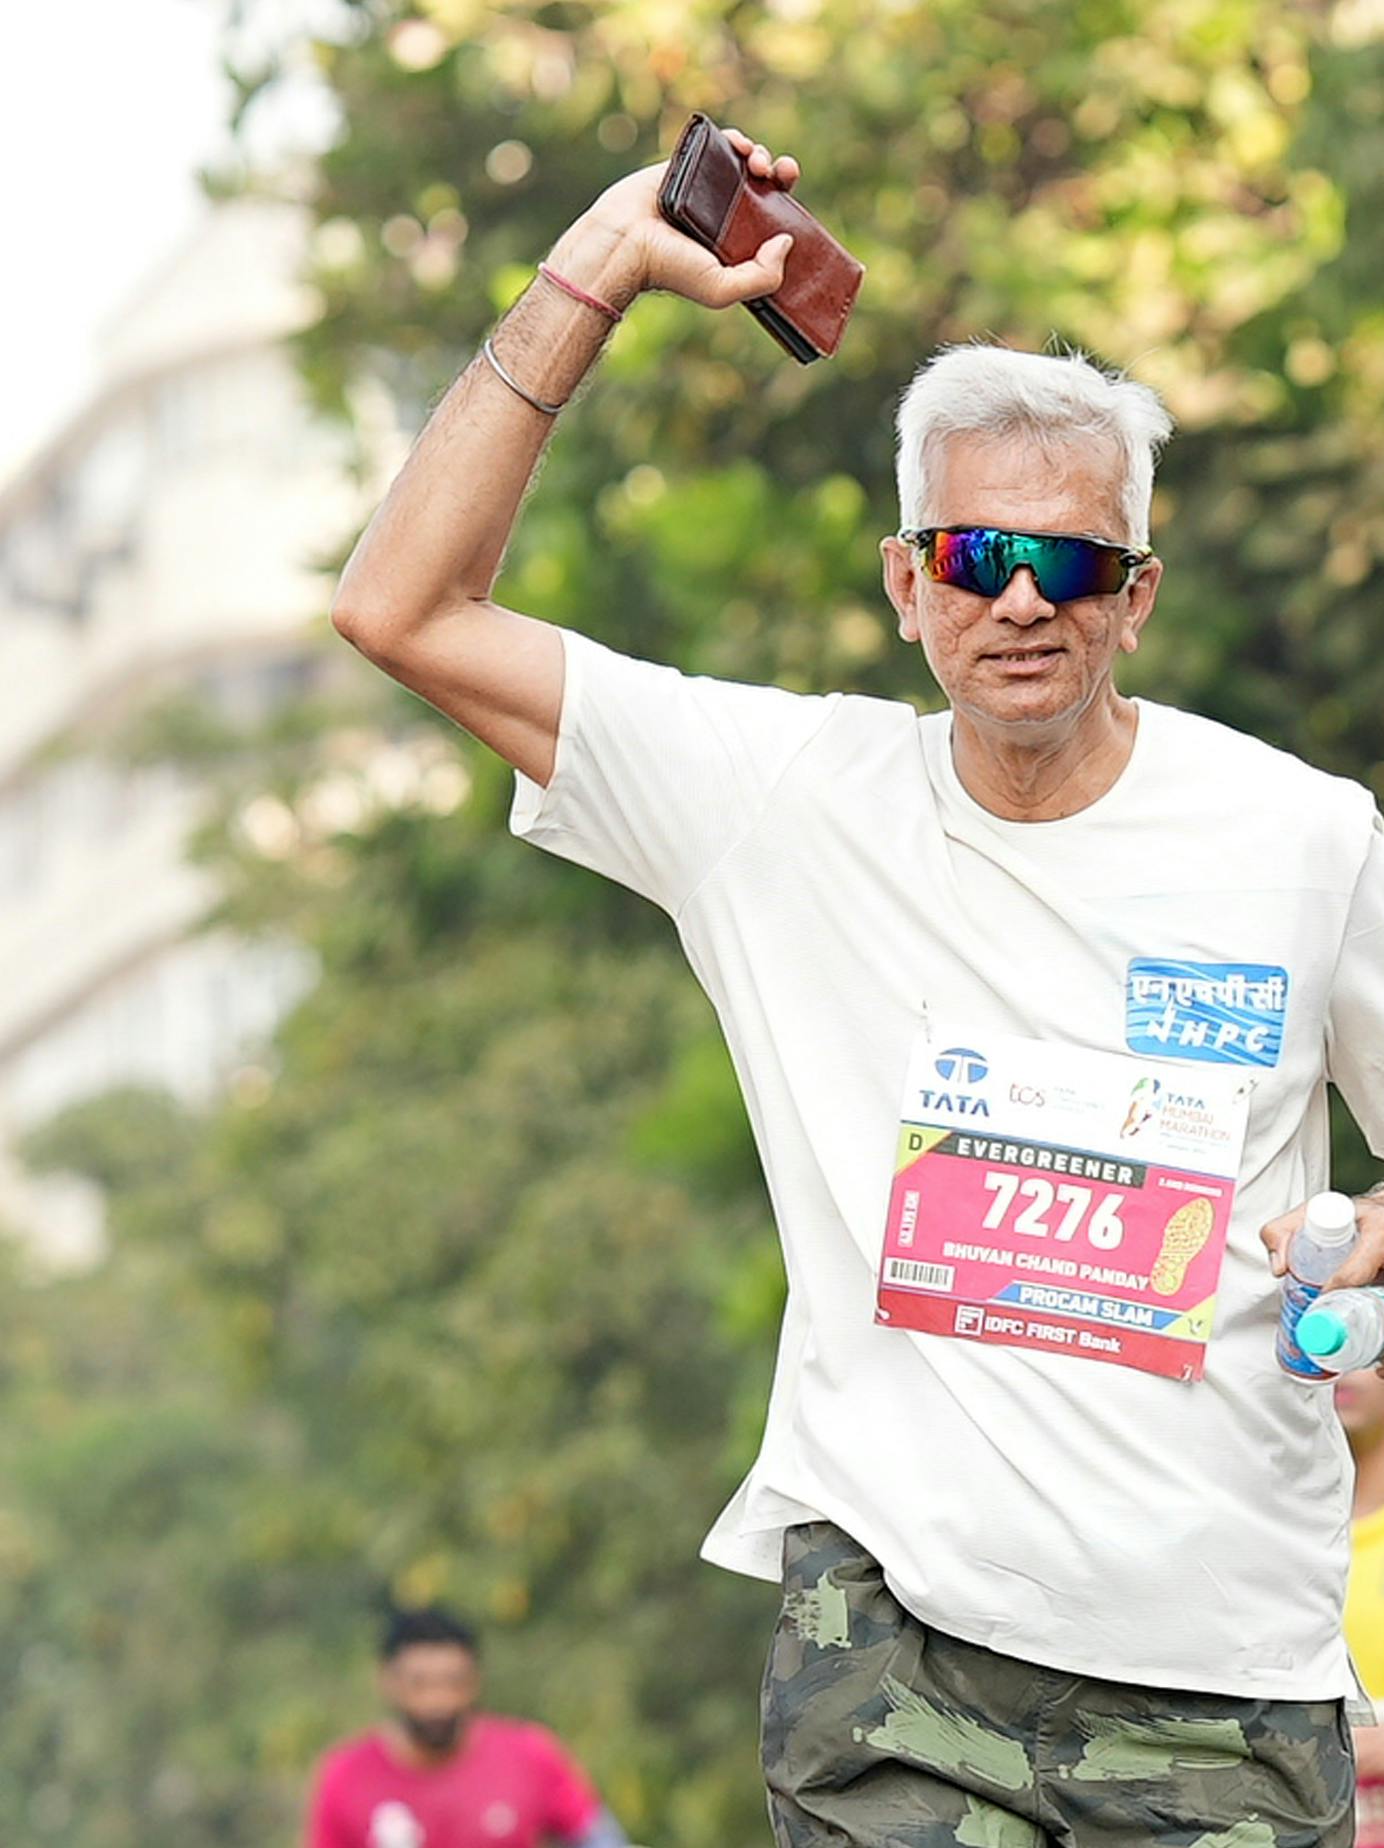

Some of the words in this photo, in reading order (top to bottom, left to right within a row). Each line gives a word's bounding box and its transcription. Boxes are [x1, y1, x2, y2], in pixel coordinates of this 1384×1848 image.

[1146, 1005, 1268, 1052] NHPC
[919, 1089, 990, 1117] TATA
[1167, 1092, 1206, 1109] TATA
[909, 1133, 923, 1151] D
[1159, 1119, 1231, 1141] MARATHON
[957, 1138, 1133, 1184] EVERGREENER
[982, 1171, 1125, 1250] 7276
[942, 1242, 1015, 1266] BHUVAN
[1015, 1253, 1077, 1279] CHAND
[1079, 1264, 1151, 1291] PANDAY
[1019, 1287, 1099, 1314] PROCAM
[1101, 1301, 1153, 1326] SLAM
[984, 1316, 1024, 1336] IDFC
[1026, 1320, 1077, 1344] FIRST
[1079, 1331, 1121, 1353] Bank
